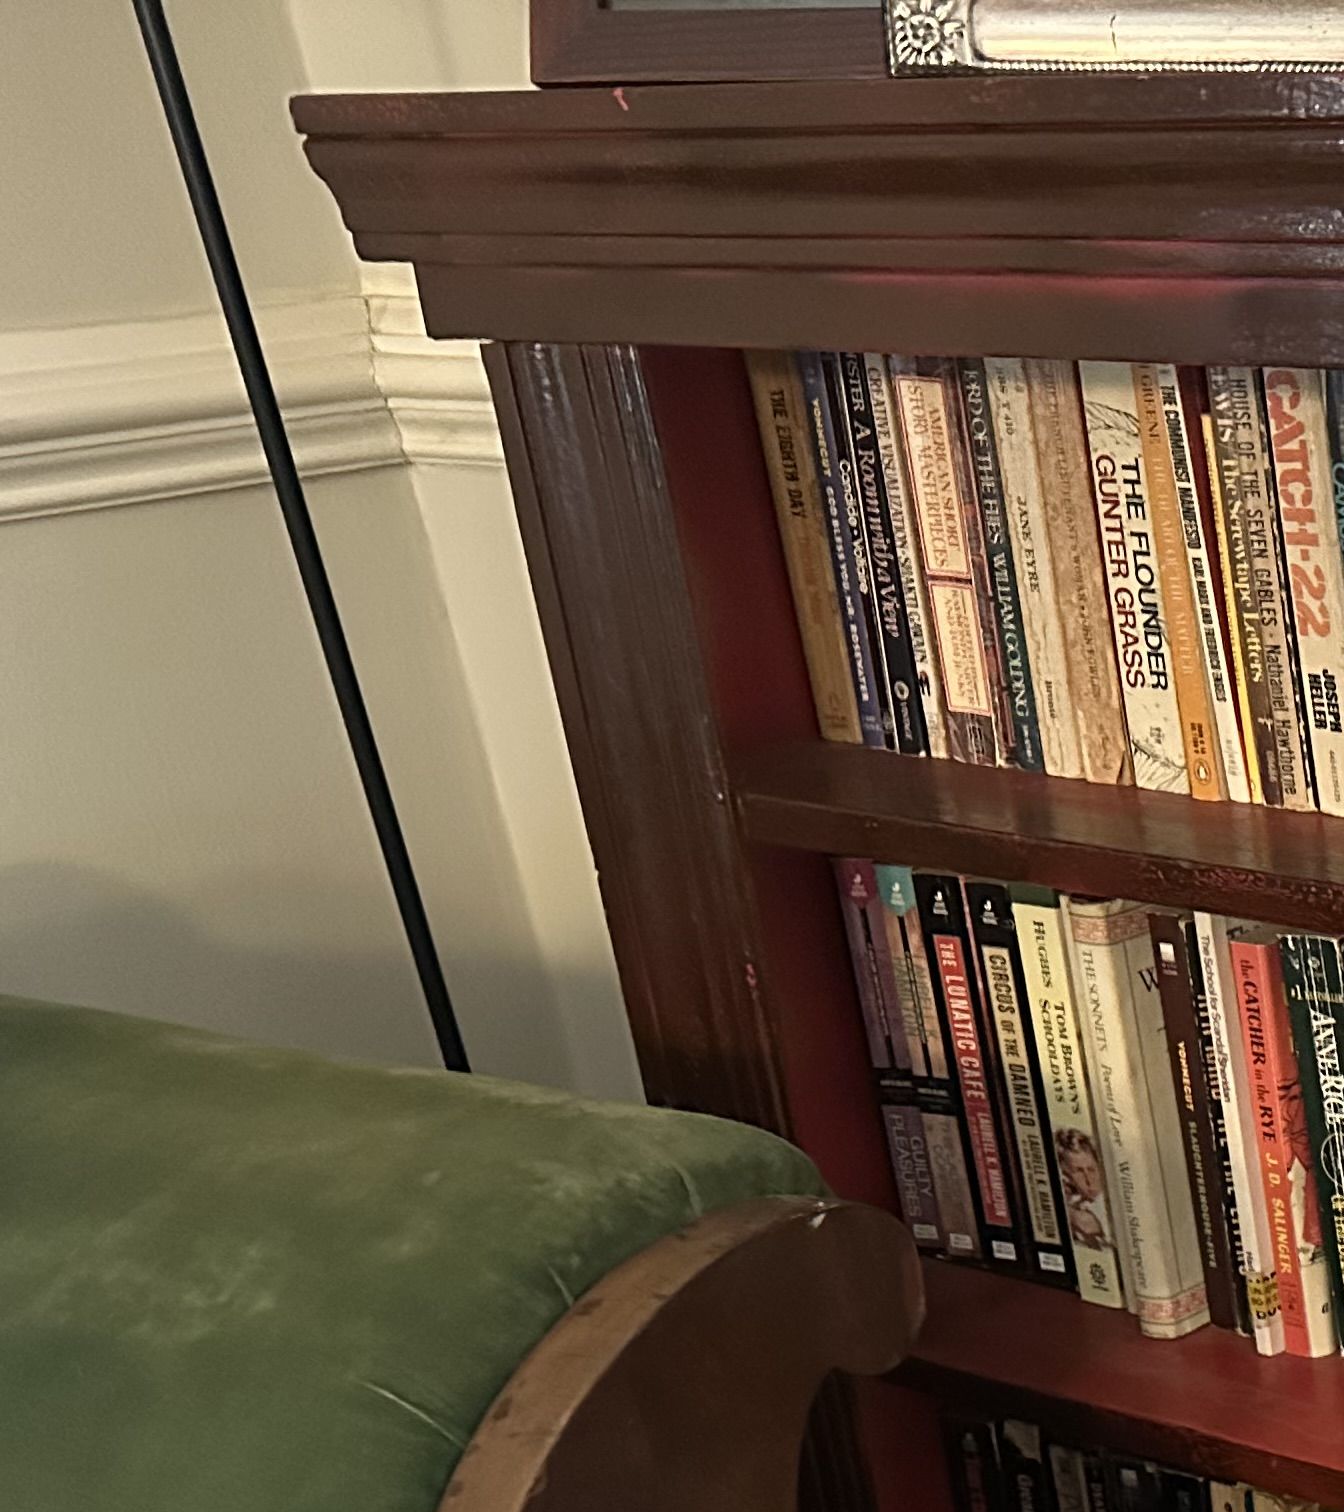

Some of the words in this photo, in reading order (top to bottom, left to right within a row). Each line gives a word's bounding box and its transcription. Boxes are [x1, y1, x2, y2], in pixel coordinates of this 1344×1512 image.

[1231, 378, 1250, 432] HOUSE
[1240, 439, 1254, 460] OF
[1120, 459, 1144, 520] THE
[1240, 467, 1260, 498] THE
[1267, 370, 1330, 639] CATCH-22
[1247, 508, 1268, 559] SEVEN
[1128, 525, 1168, 690] FLOUNDER
[1254, 569, 1277, 625] GABLES
[1114, 586, 1145, 688] GRASS
[1265, 645, 1284, 715] Nathaniel
[1308, 672, 1328, 729] HELLER
[1321, 670, 1342, 733] JOSEPH
[1276, 718, 1296, 795] Hawthorne
[988, 956, 1014, 1014] CIRCUS
[1005, 1035, 1019, 1059] THE
[1008, 1063, 1035, 1127] DAMNED
[1242, 981, 1266, 1065] CATCHER
[1271, 1197, 1293, 1274] SALINGER
